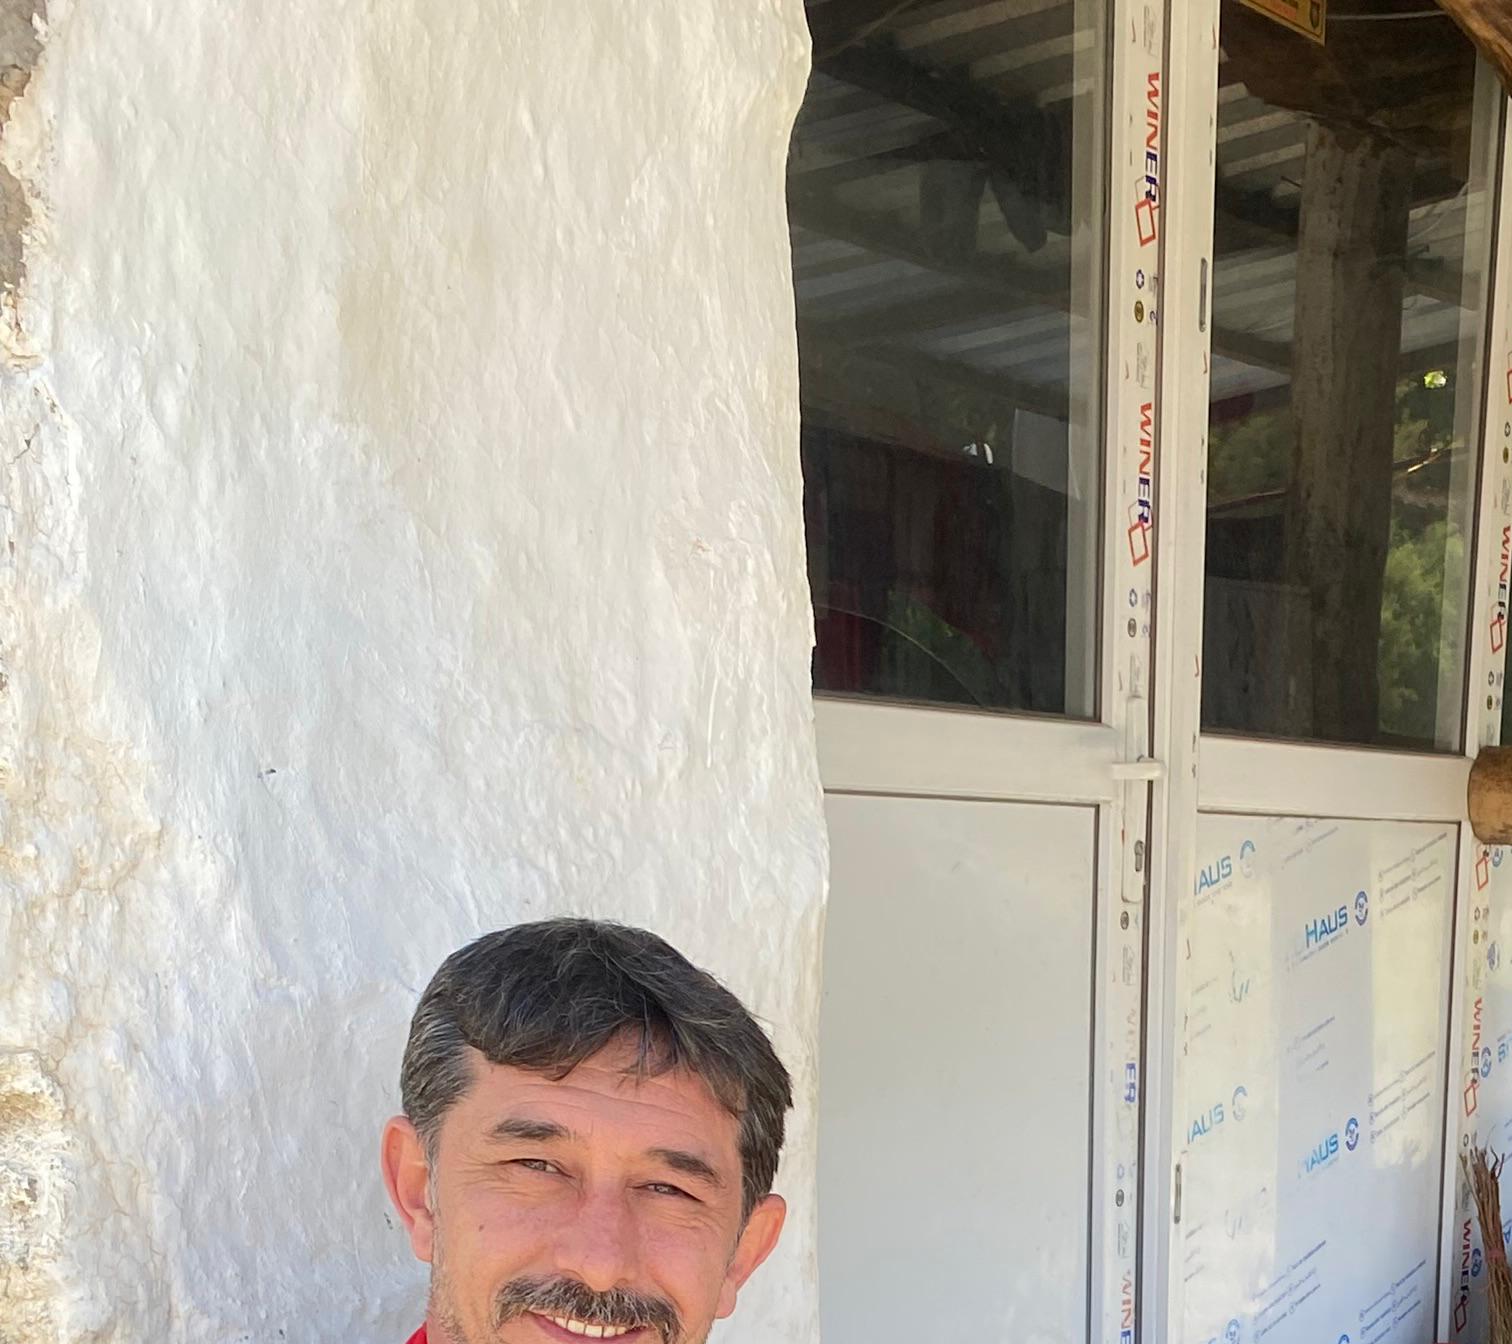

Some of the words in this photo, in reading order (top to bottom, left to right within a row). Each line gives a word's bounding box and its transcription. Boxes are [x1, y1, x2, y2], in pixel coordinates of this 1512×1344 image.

[1145, 72, 1160, 202] WINER
[1138, 402, 1152, 523] WINER
[1497, 526, 1511, 620] WINER
